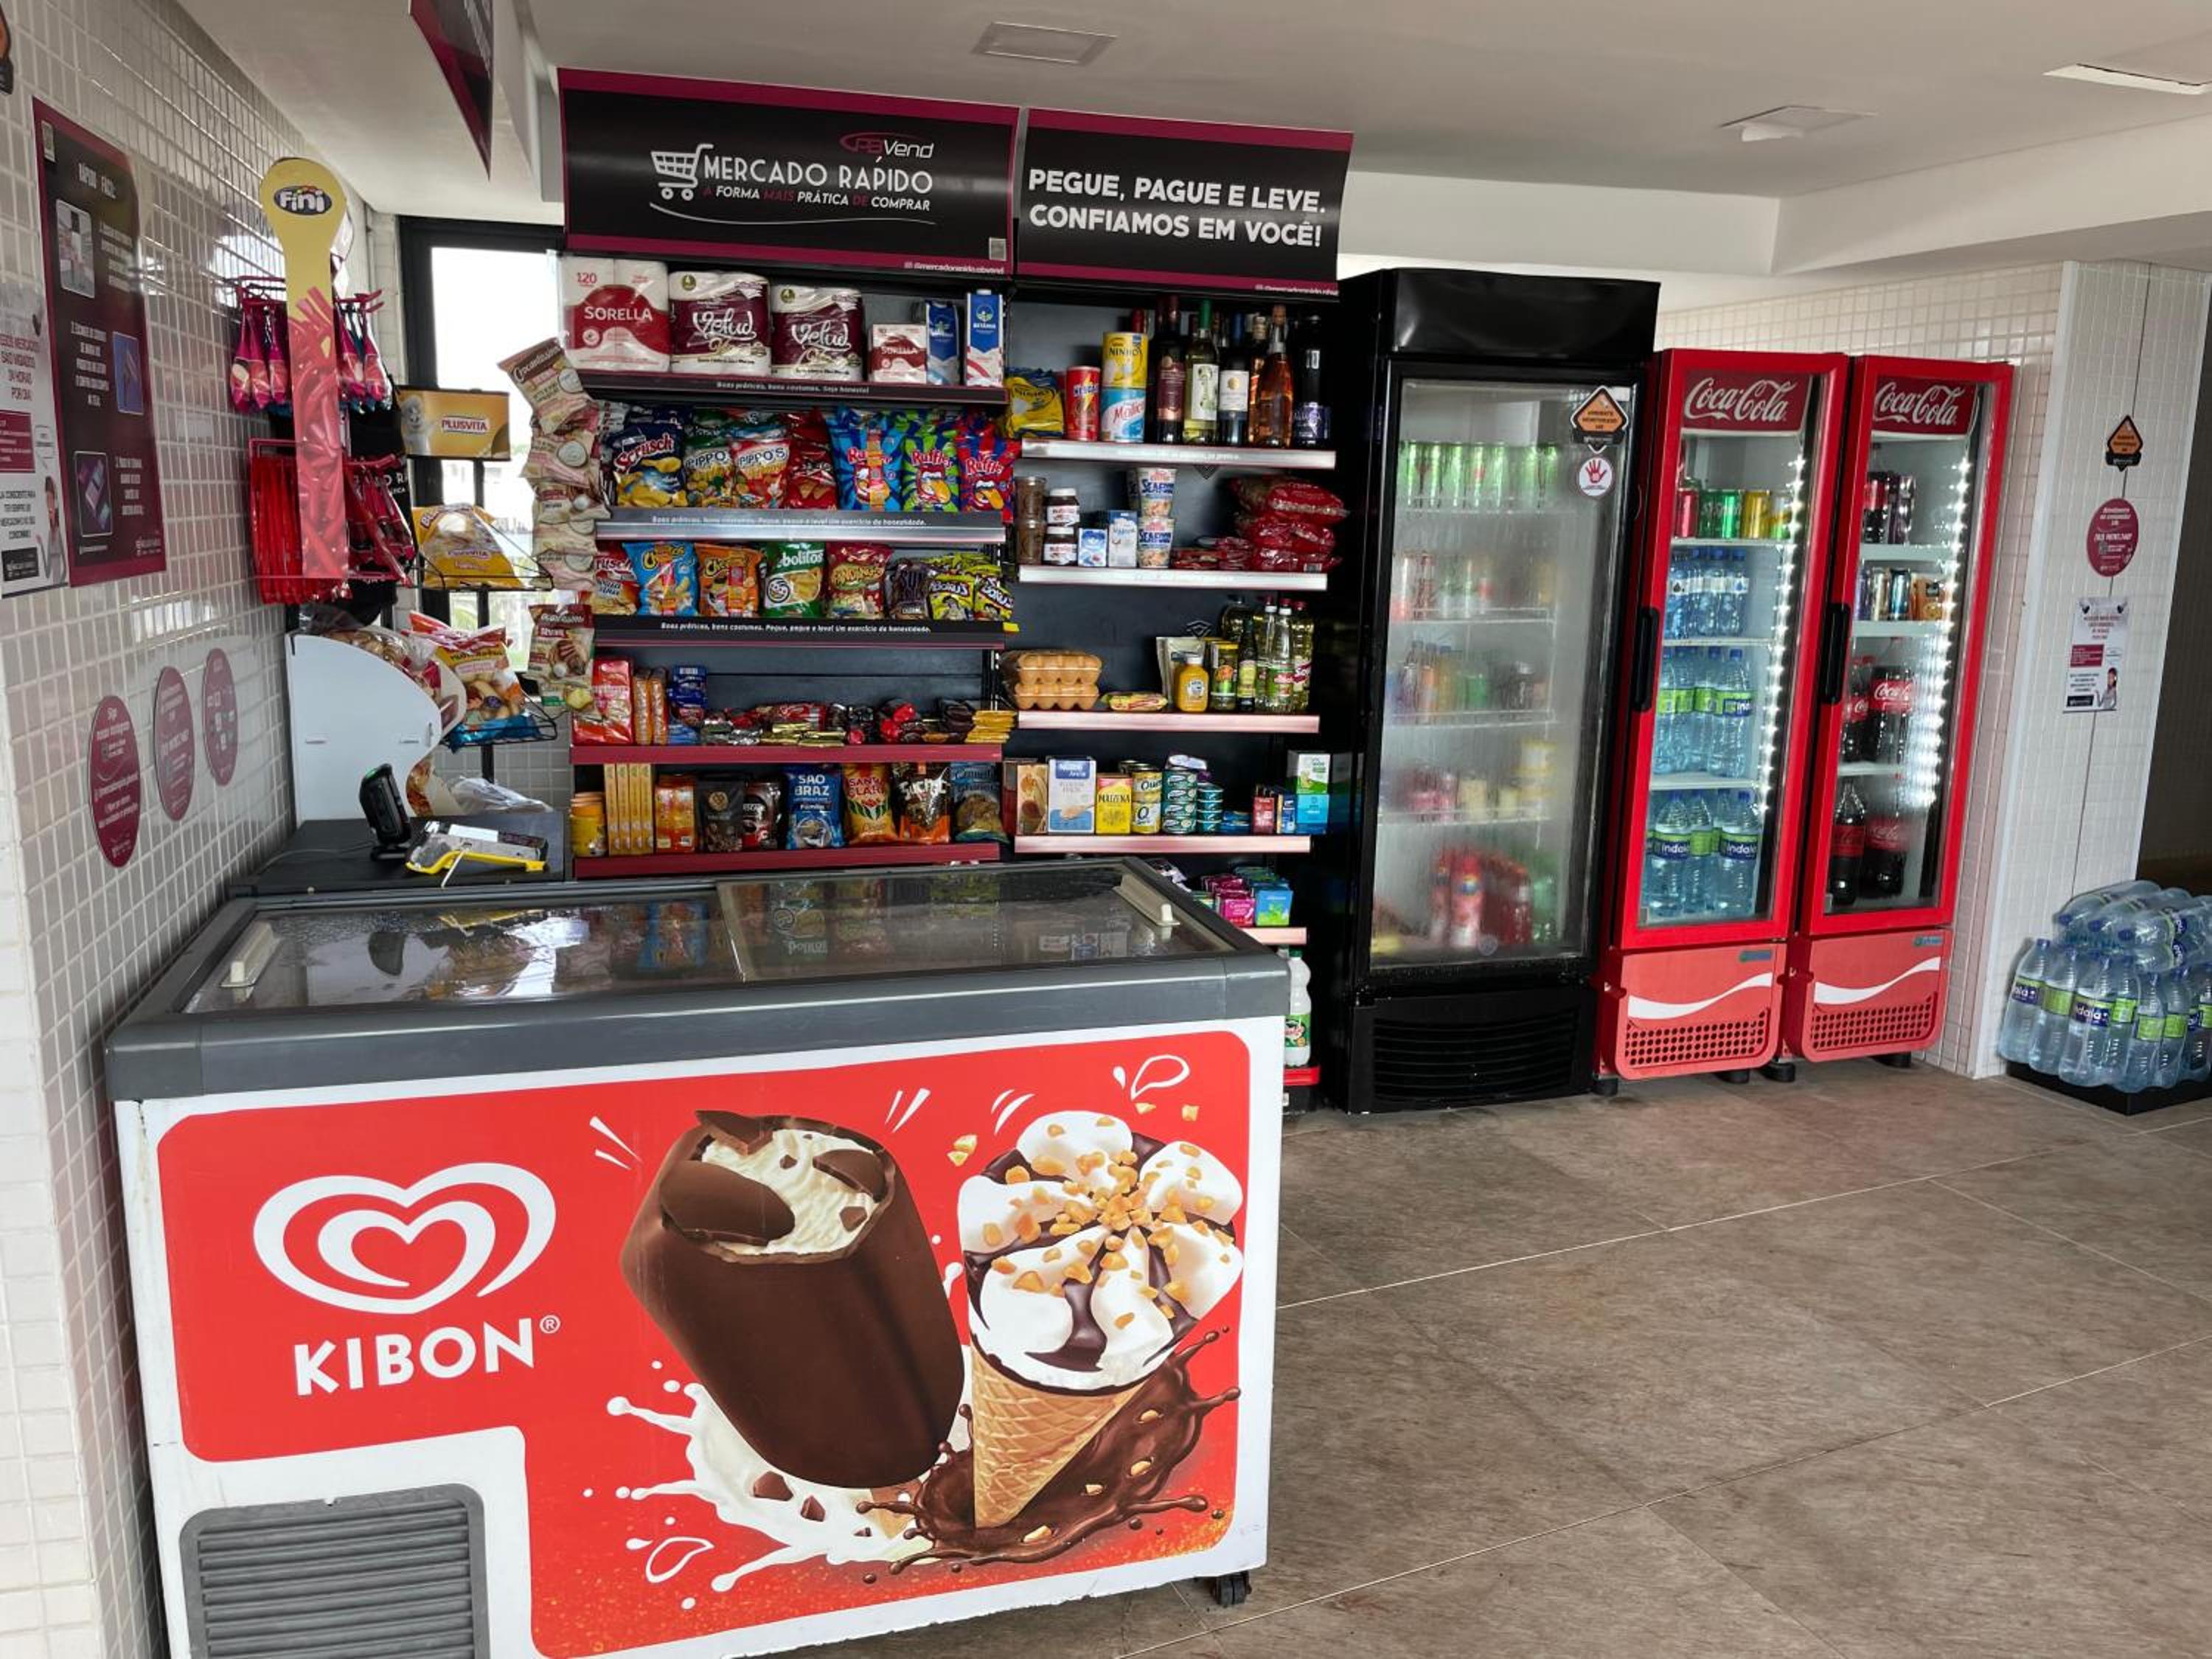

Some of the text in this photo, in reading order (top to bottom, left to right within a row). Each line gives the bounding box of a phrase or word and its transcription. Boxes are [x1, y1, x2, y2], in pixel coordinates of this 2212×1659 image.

[703, 154, 933, 193] MERCADO RÁPIDO
[1029, 169, 1325, 212] PEGUE, PAGUE E LEVE.
[280, 189, 324, 212] Fini
[716, 185, 760, 199] FORMA
[763, 189, 795, 201] MAIS
[797, 189, 849, 205] PRÁTICA
[852, 196, 868, 206] DE
[872, 196, 931, 211] COMPRAR
[1029, 204, 1321, 247] CONFIAMOS EM VOCÊ!
[584, 306, 653, 321] SORELLA
[1683, 377, 1797, 422] Coca-Cola
[1874, 381, 1965, 426] Coca-Cola
[442, 419, 487, 432] PLUSVITA
[795, 785, 830, 796] BRAZ
[294, 1318, 534, 1396] KIBON
